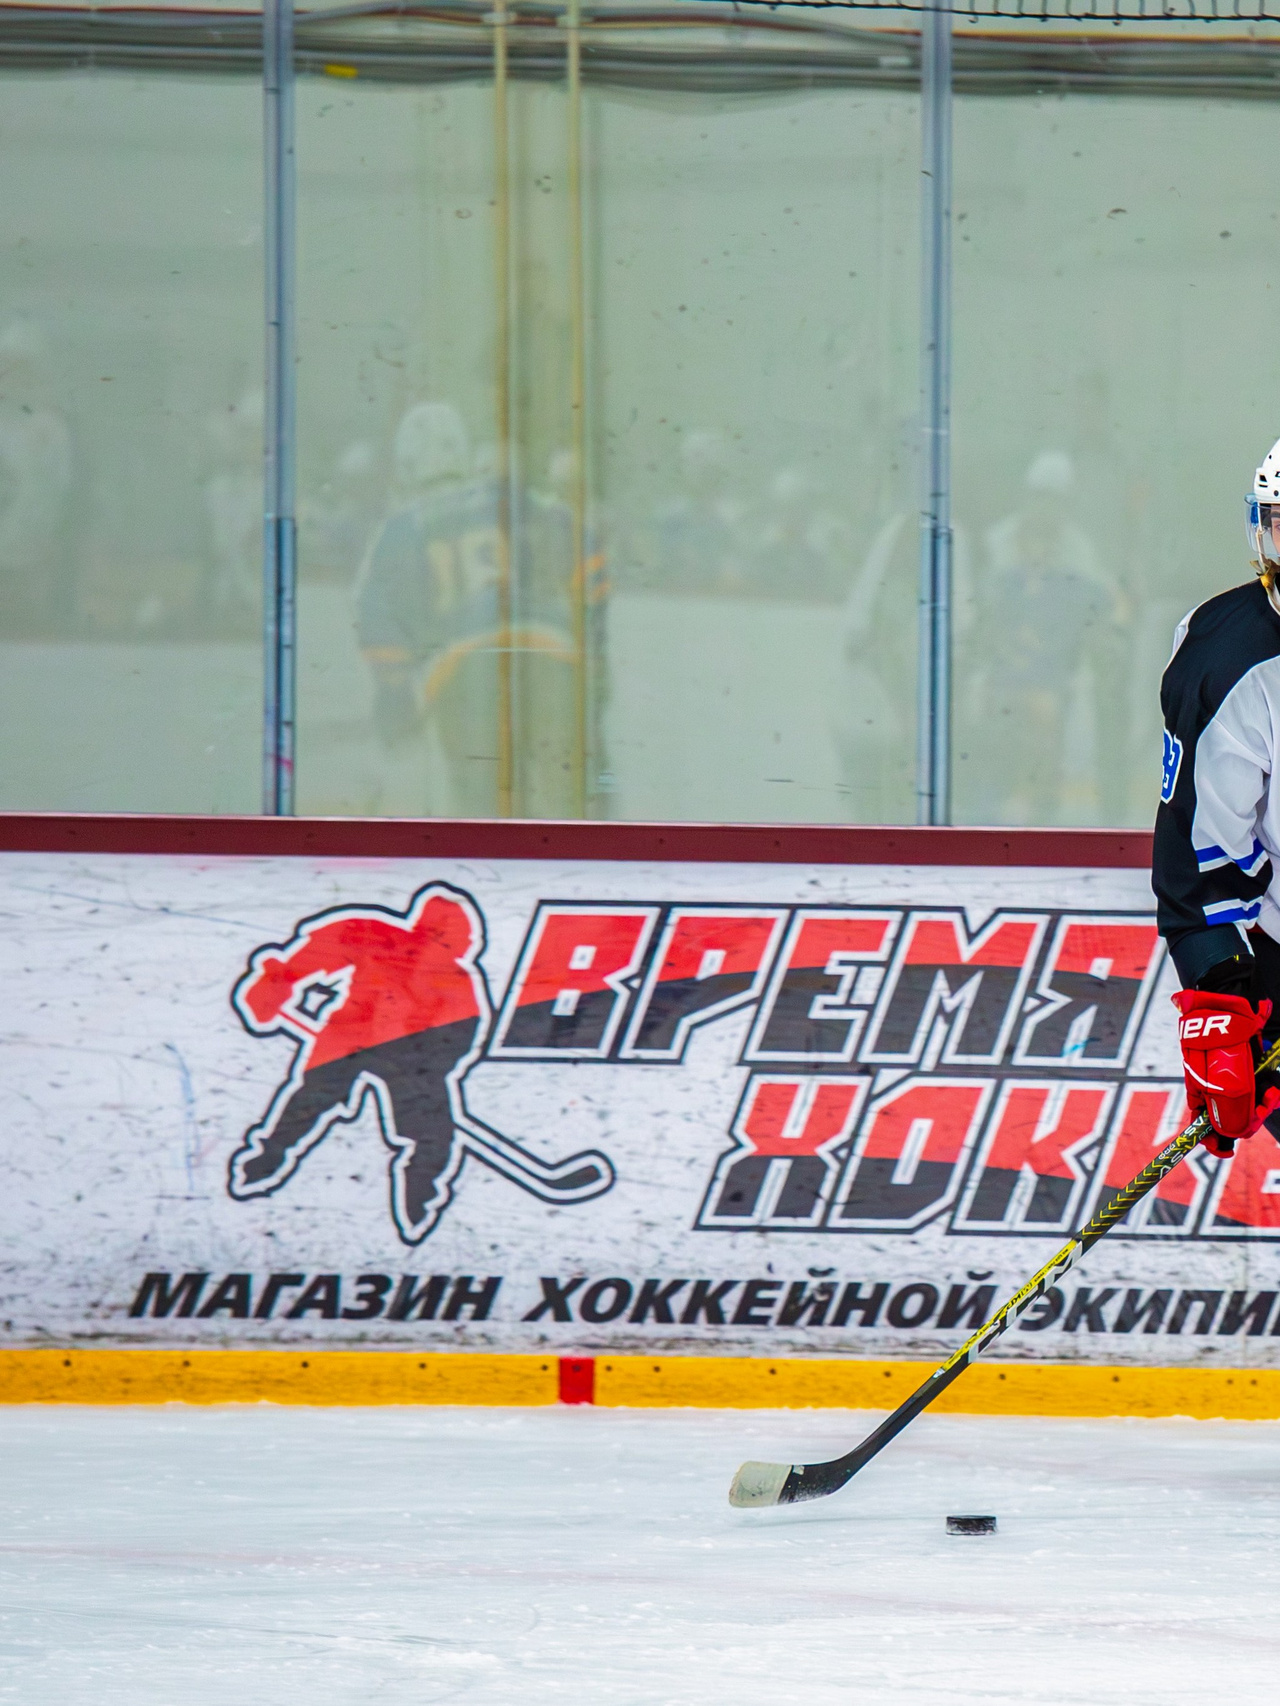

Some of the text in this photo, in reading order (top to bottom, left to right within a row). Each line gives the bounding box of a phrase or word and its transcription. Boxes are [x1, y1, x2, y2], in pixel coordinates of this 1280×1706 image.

[486, 900, 1170, 1074] ВРЕМЯ
[128, 1272, 503, 1320] МАГАЗИН
[521, 1266, 1000, 1331] ХОККЕЙНОЙ
